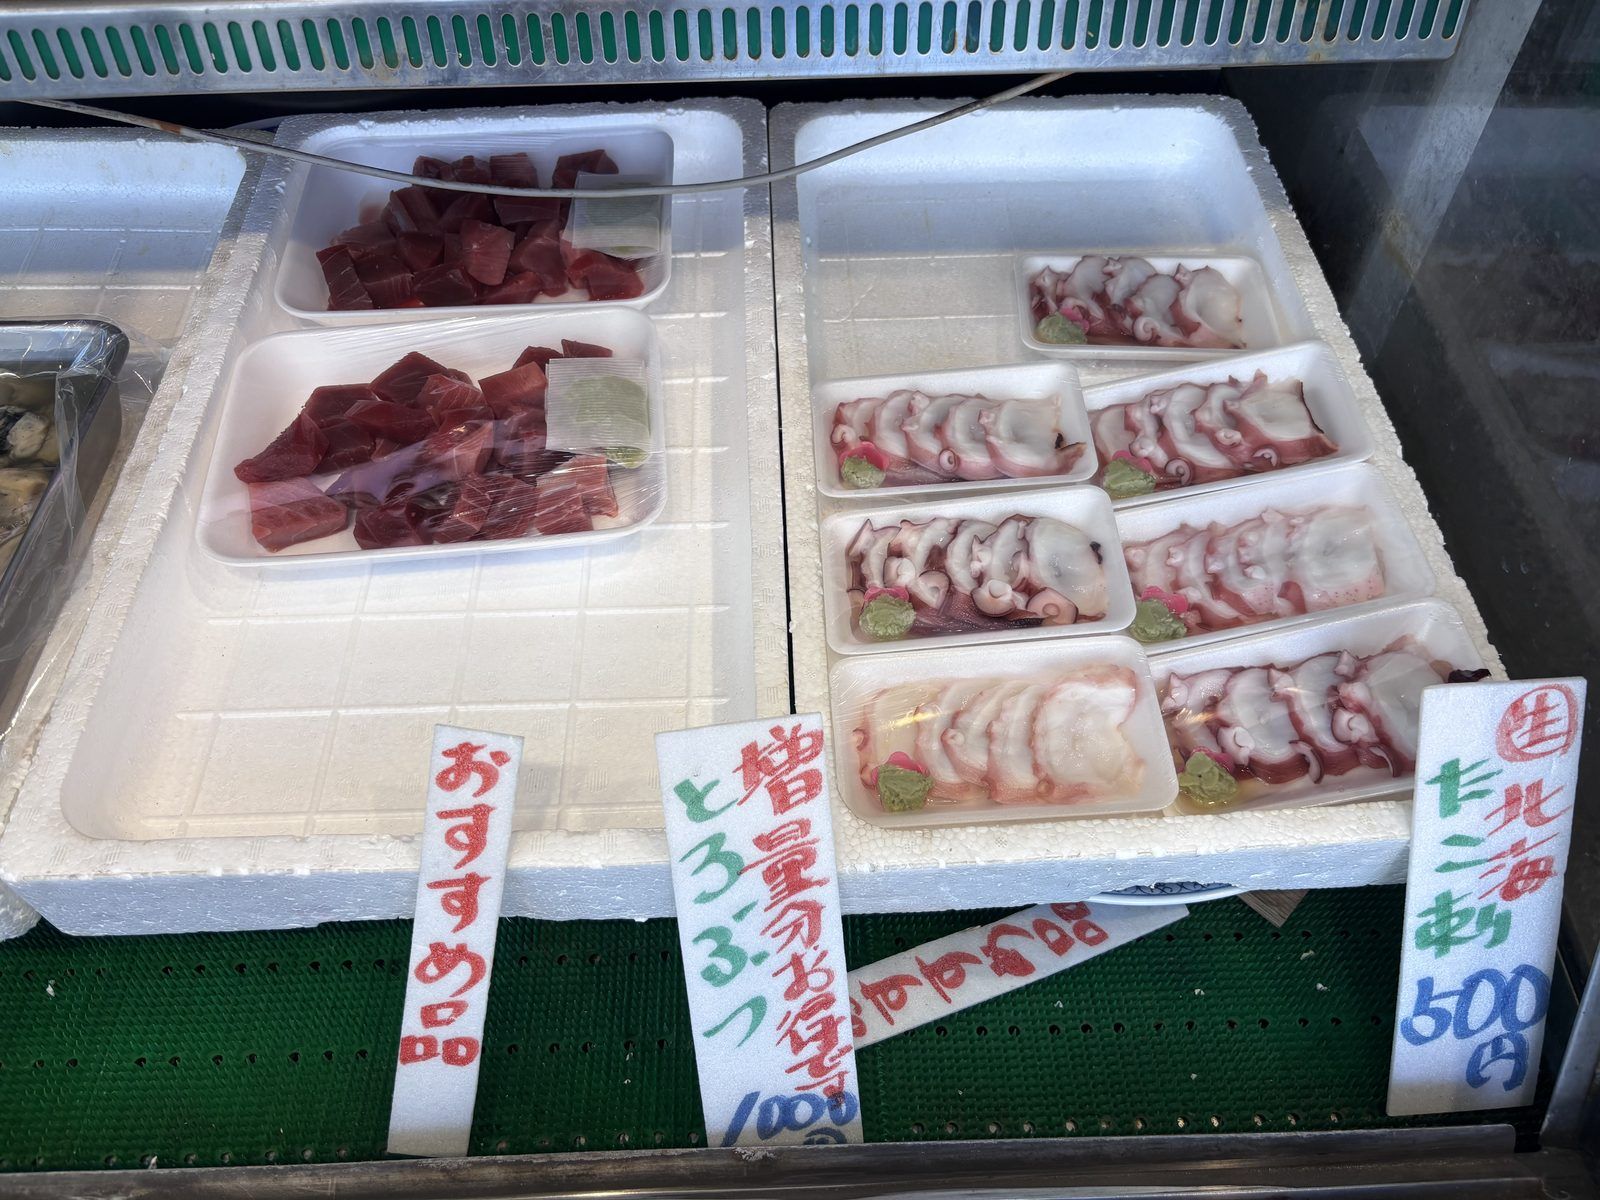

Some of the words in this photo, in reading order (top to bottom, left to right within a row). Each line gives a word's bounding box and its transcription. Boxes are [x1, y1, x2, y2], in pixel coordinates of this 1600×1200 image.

[400, 742, 510, 1066] おすすめ品
